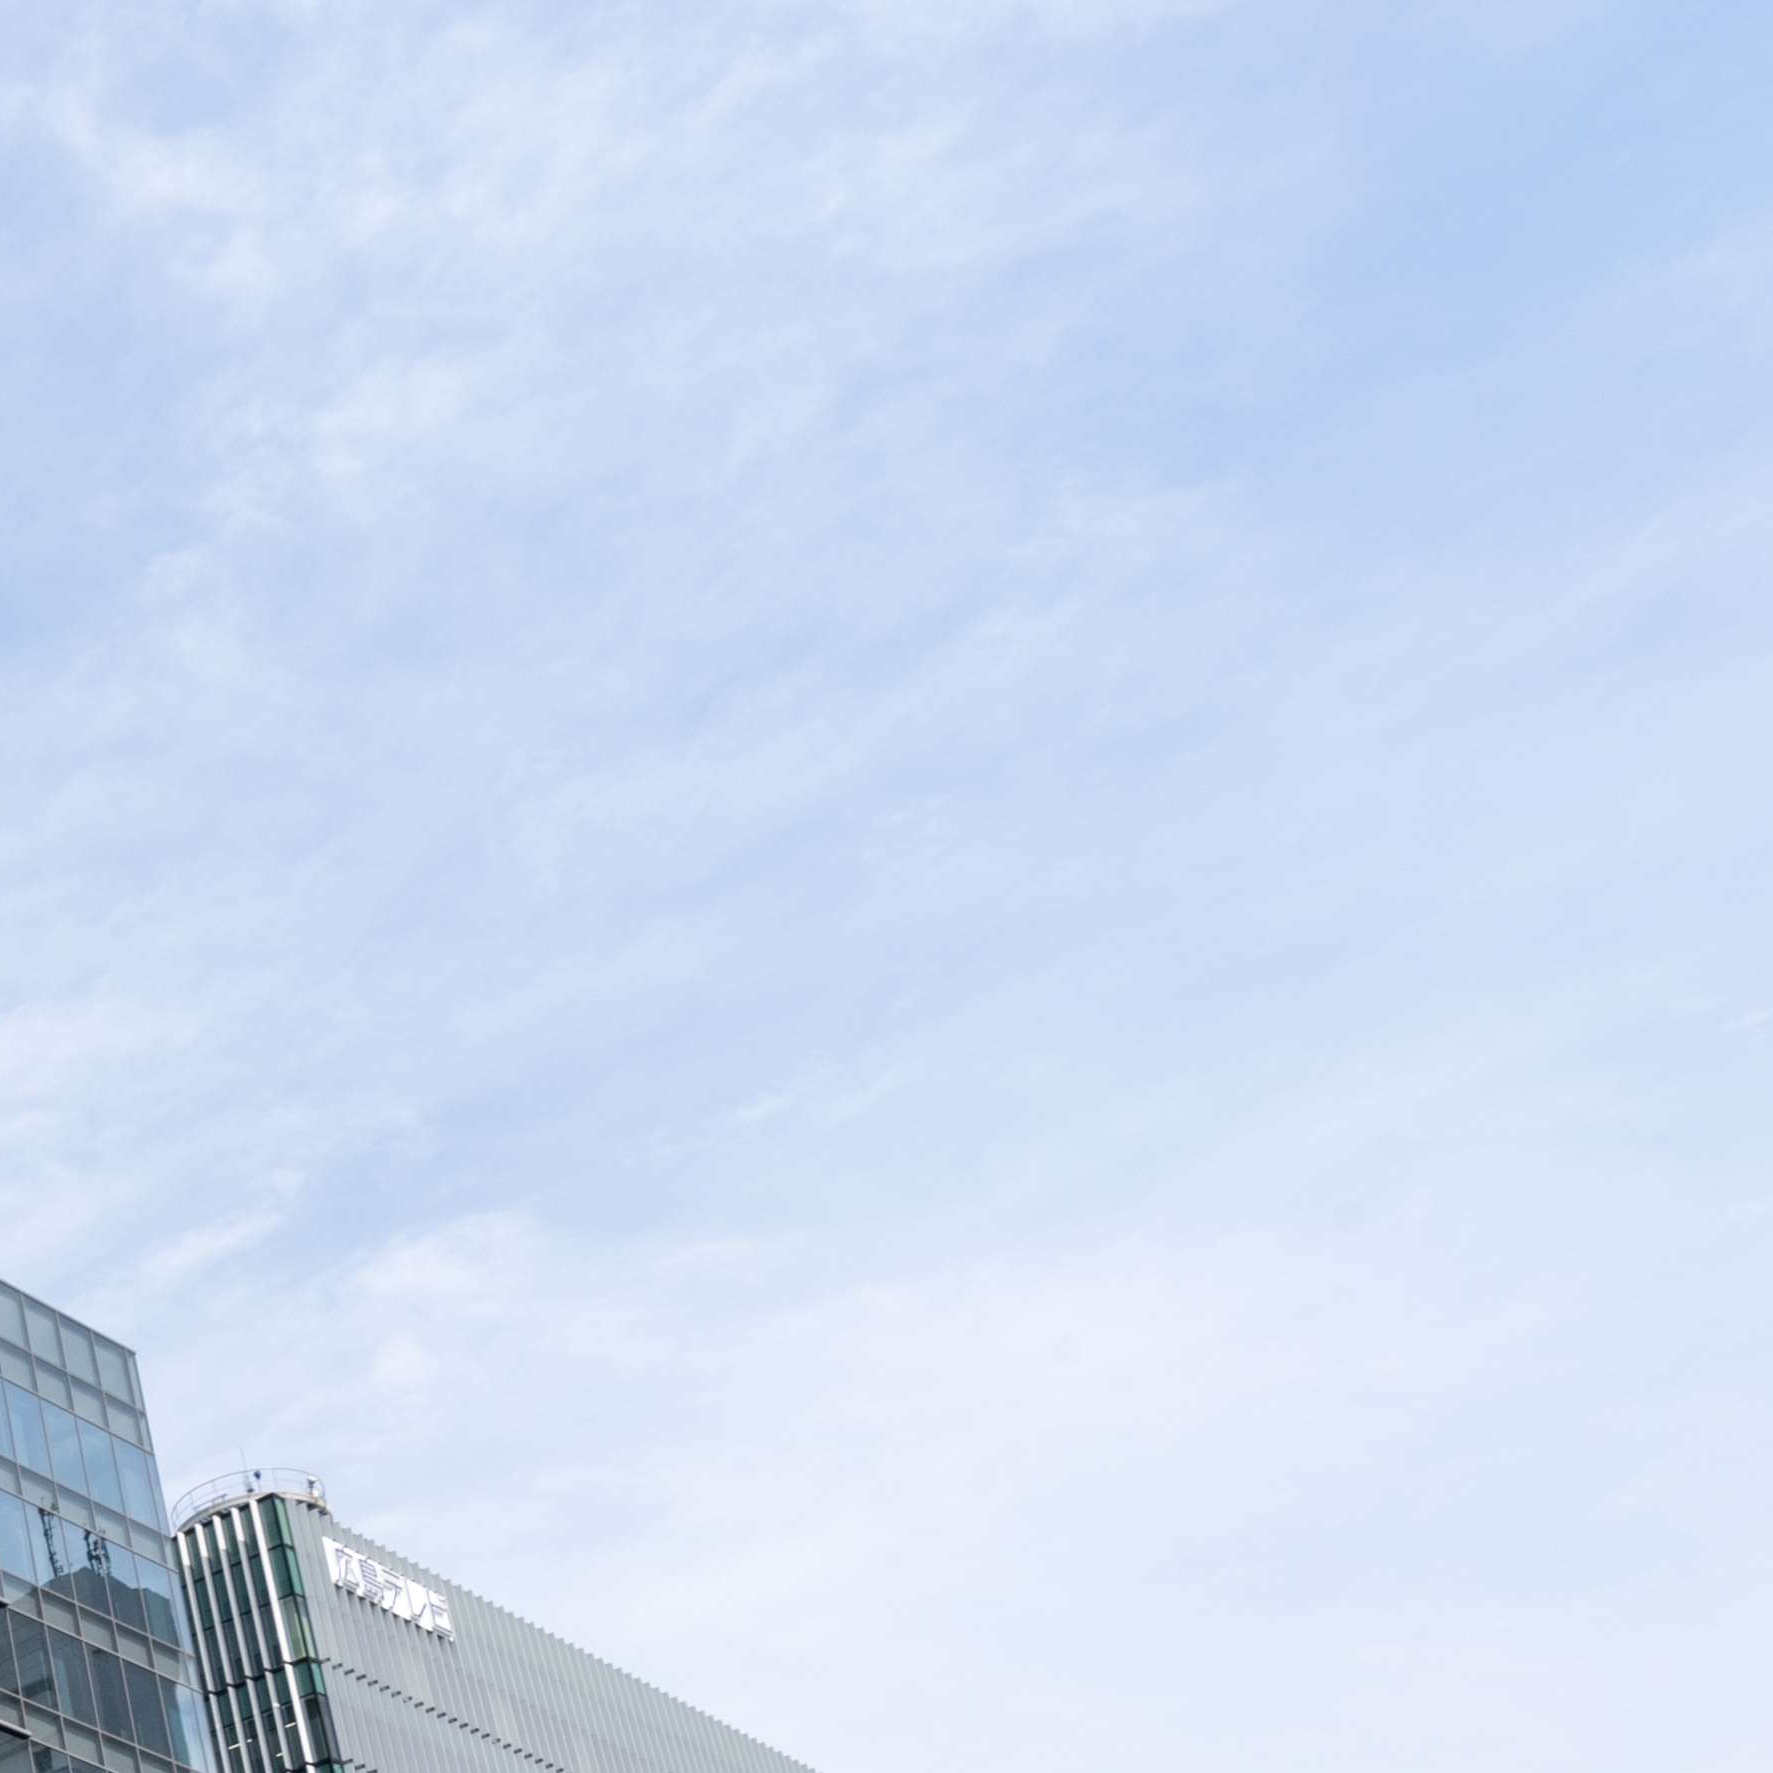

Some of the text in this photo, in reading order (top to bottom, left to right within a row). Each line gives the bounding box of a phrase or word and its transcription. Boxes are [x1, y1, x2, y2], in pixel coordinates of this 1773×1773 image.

[333, 1545, 454, 1640] 広島テレビ
